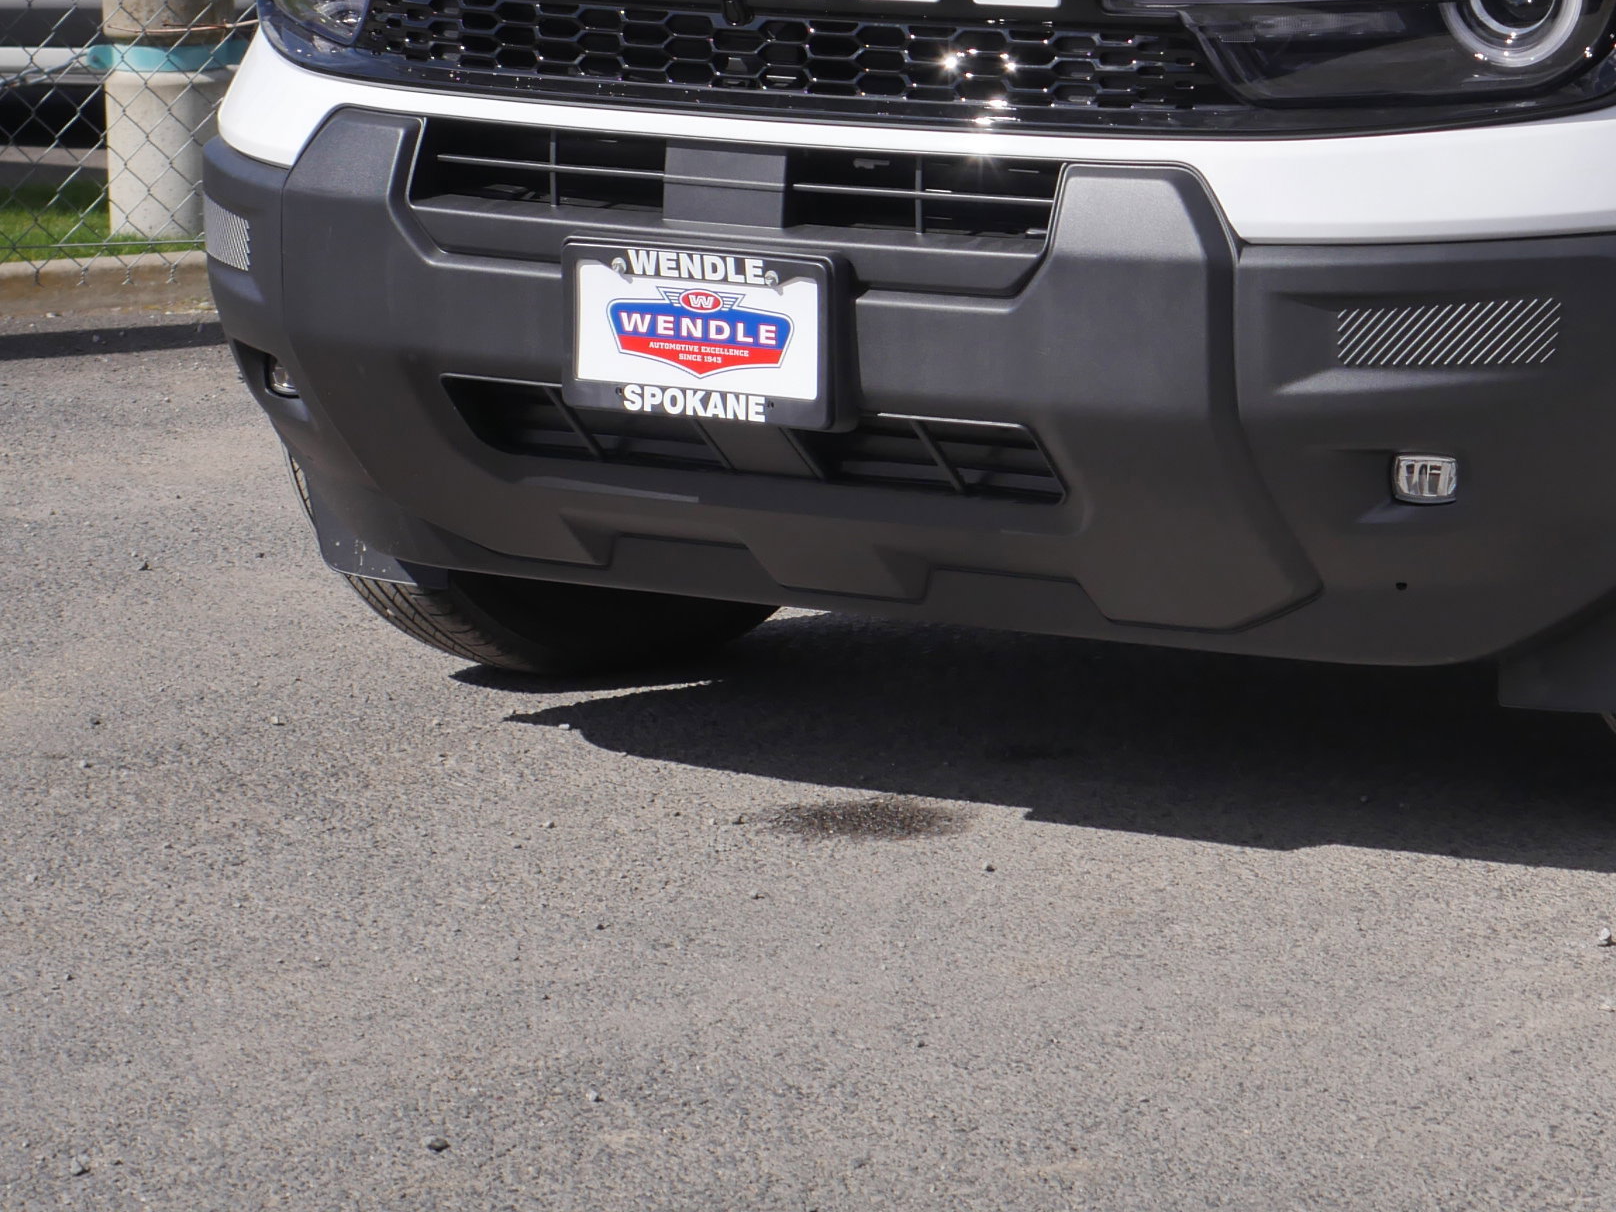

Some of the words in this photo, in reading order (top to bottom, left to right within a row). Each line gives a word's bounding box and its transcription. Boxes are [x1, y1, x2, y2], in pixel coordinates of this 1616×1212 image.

[627, 249, 766, 285] WENDLE
[619, 311, 777, 346] WENDLE
[649, 341, 699, 352] AUTOMOTIVE
[701, 346, 749, 357] EXCELLENCE
[679, 353, 702, 362] SINCE
[704, 355, 722, 364] 1943
[624, 384, 766, 422] SPOKANE
